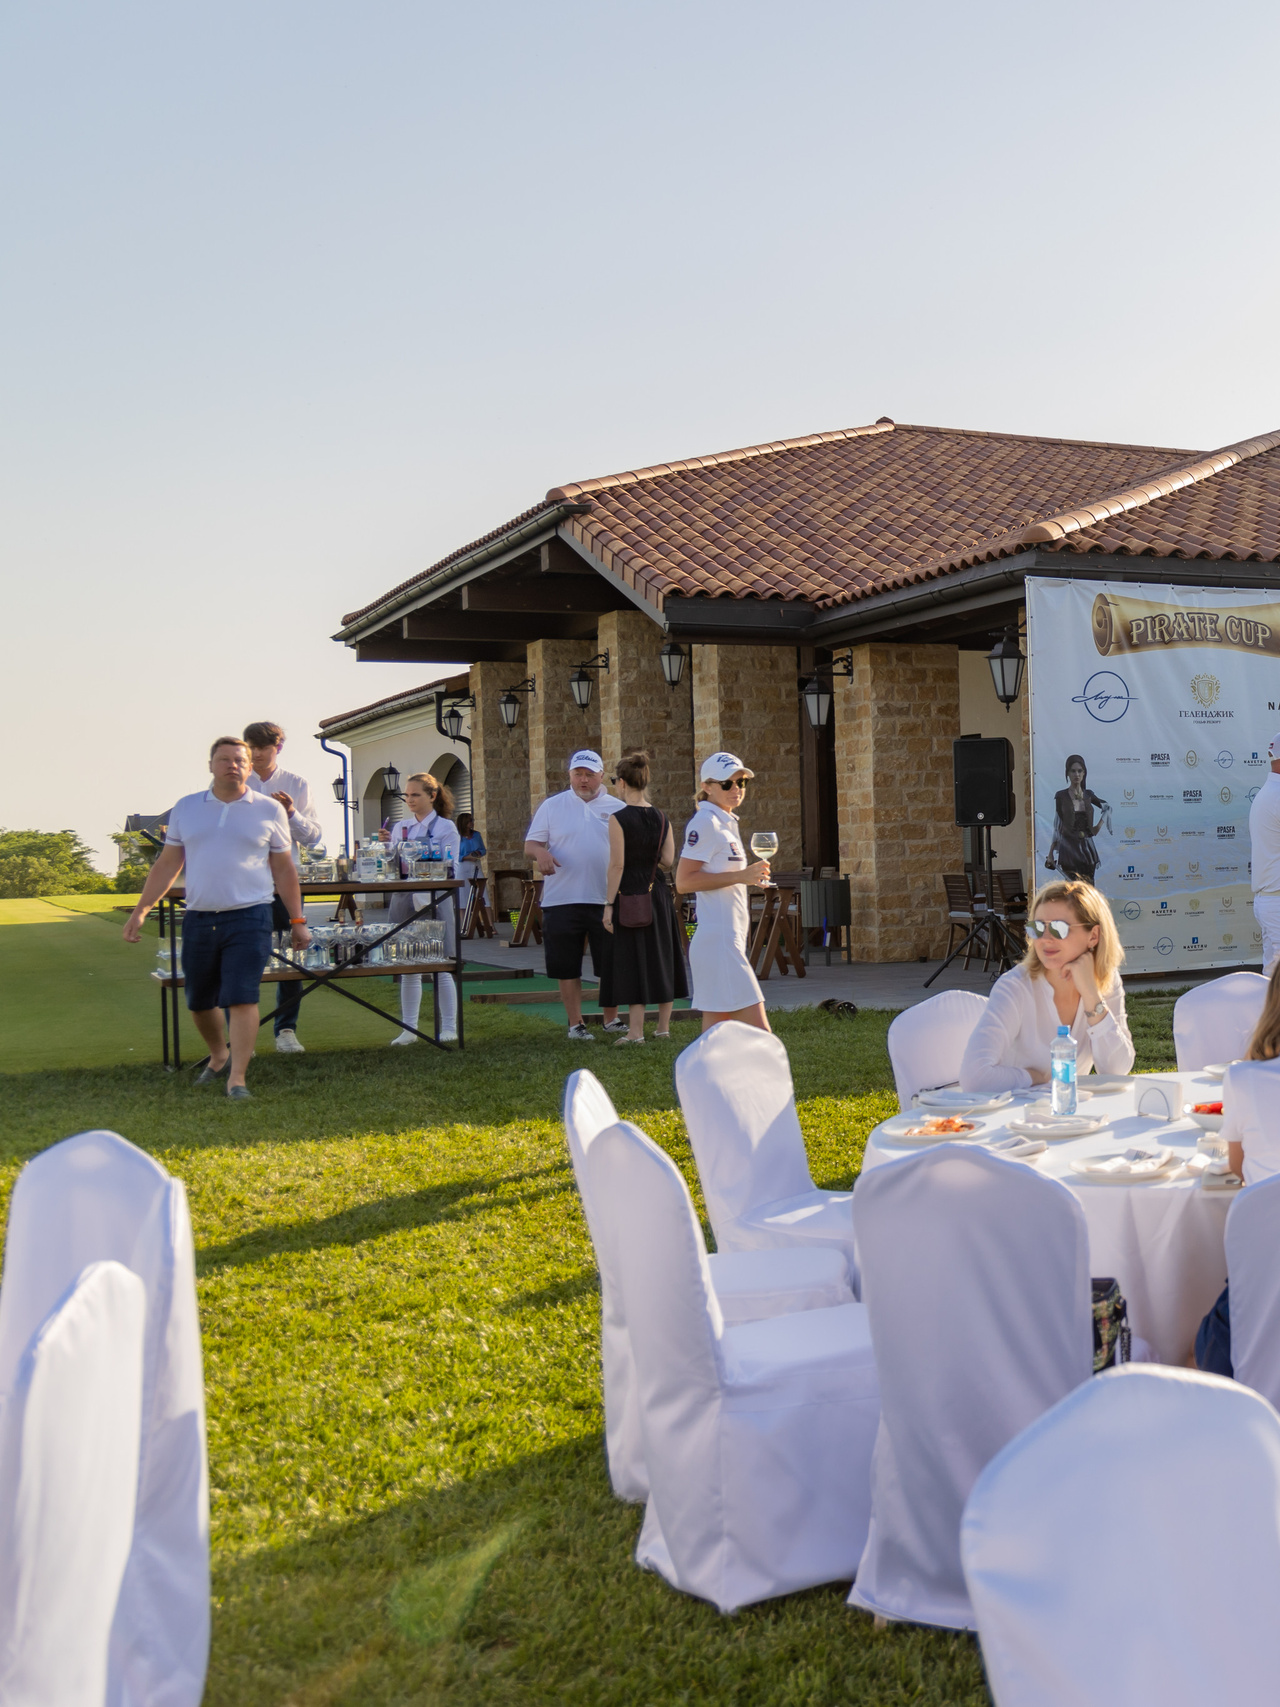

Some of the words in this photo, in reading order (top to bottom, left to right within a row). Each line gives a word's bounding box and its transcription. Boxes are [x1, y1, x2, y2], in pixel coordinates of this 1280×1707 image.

[1129, 612, 1222, 645] PIRATE
[1225, 615, 1272, 648] CUP
[1178, 710, 1234, 718] ГЕЛЕНДЖИК
